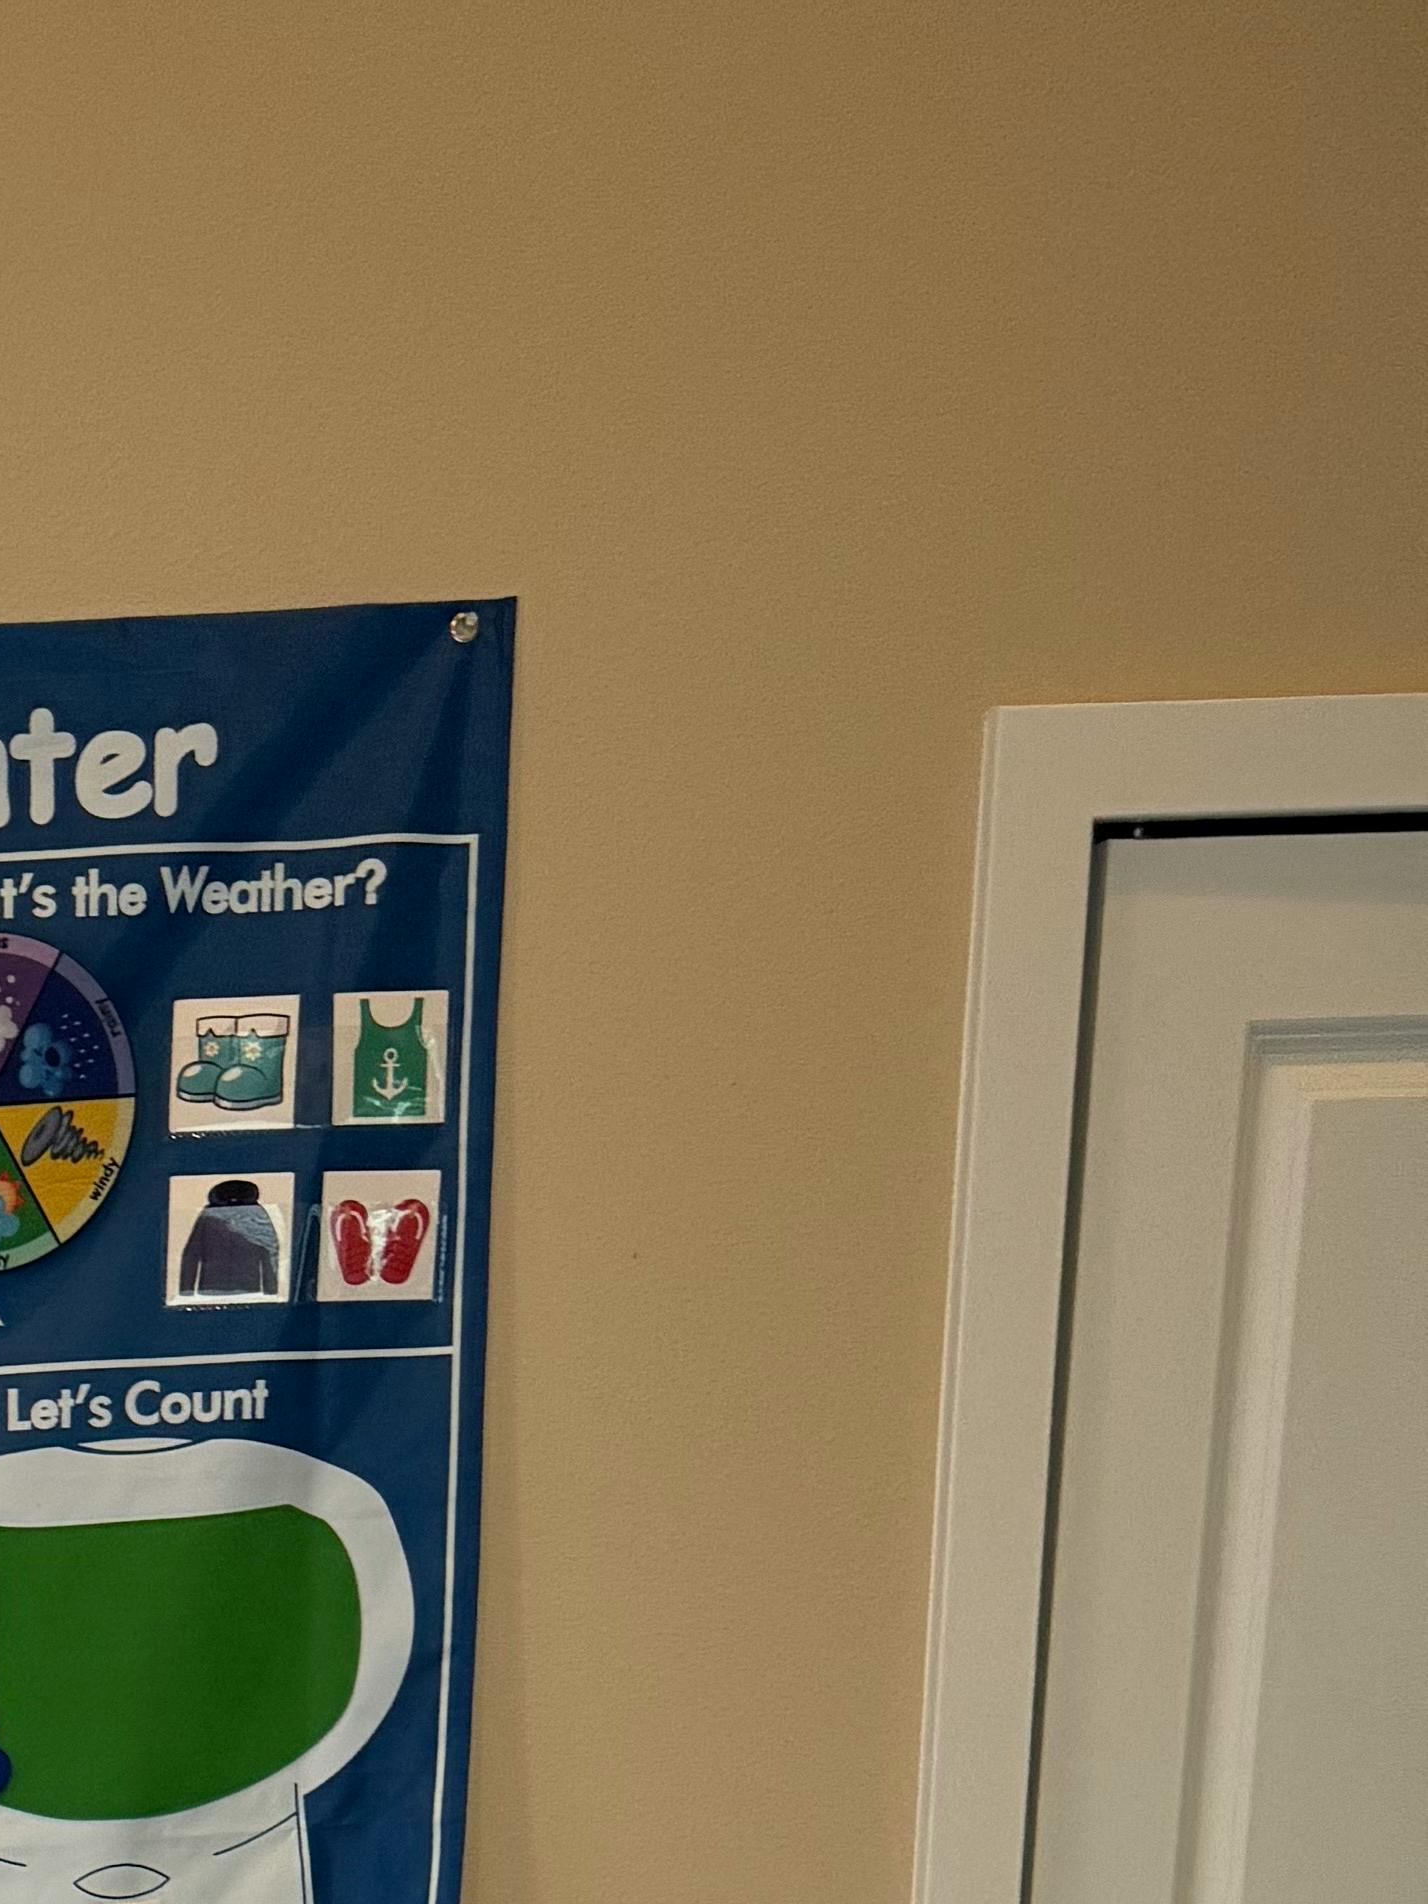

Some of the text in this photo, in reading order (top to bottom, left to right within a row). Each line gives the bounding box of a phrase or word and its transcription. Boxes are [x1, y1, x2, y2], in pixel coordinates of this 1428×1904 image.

[72, 869, 146, 916] the
[160, 858, 387, 914] Weather?
[89, 1157, 121, 1202] windy
[6, 1379, 268, 1432] Let's Count
